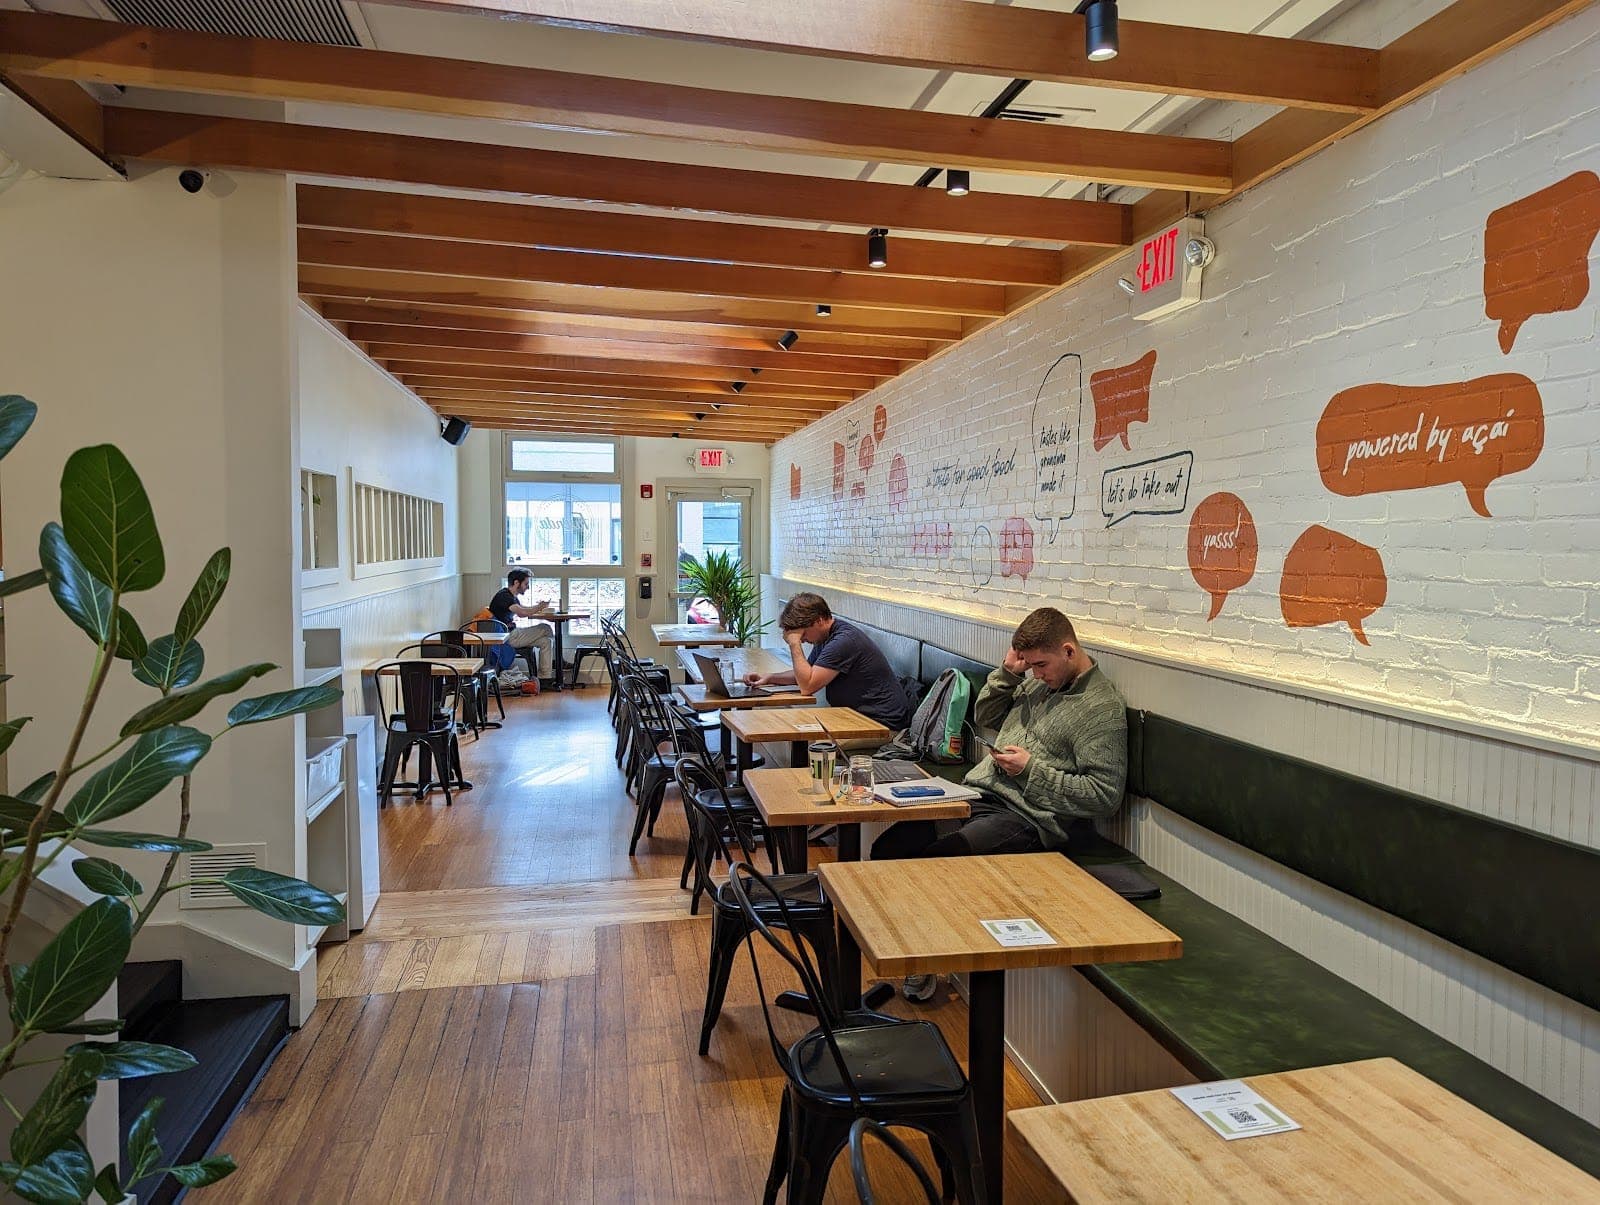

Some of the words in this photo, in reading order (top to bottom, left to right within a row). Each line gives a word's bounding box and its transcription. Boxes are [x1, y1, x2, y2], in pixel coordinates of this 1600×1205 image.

[1141, 227, 1179, 293] EXIT
[1040, 425, 1058, 448] tastes
[1342, 412, 1425, 476] powered
[1425, 415, 1453, 463] by
[700, 450, 723, 468] EXIT
[960, 455, 990, 509] good
[985, 447, 1017, 496] food
[1058, 469, 1066, 492] it
[1107, 478, 1125, 504] let's
[1128, 475, 1138, 500] do
[1141, 470, 1161, 500] take
[1165, 467, 1183, 497] out
[1203, 512, 1241, 560] yasss!
